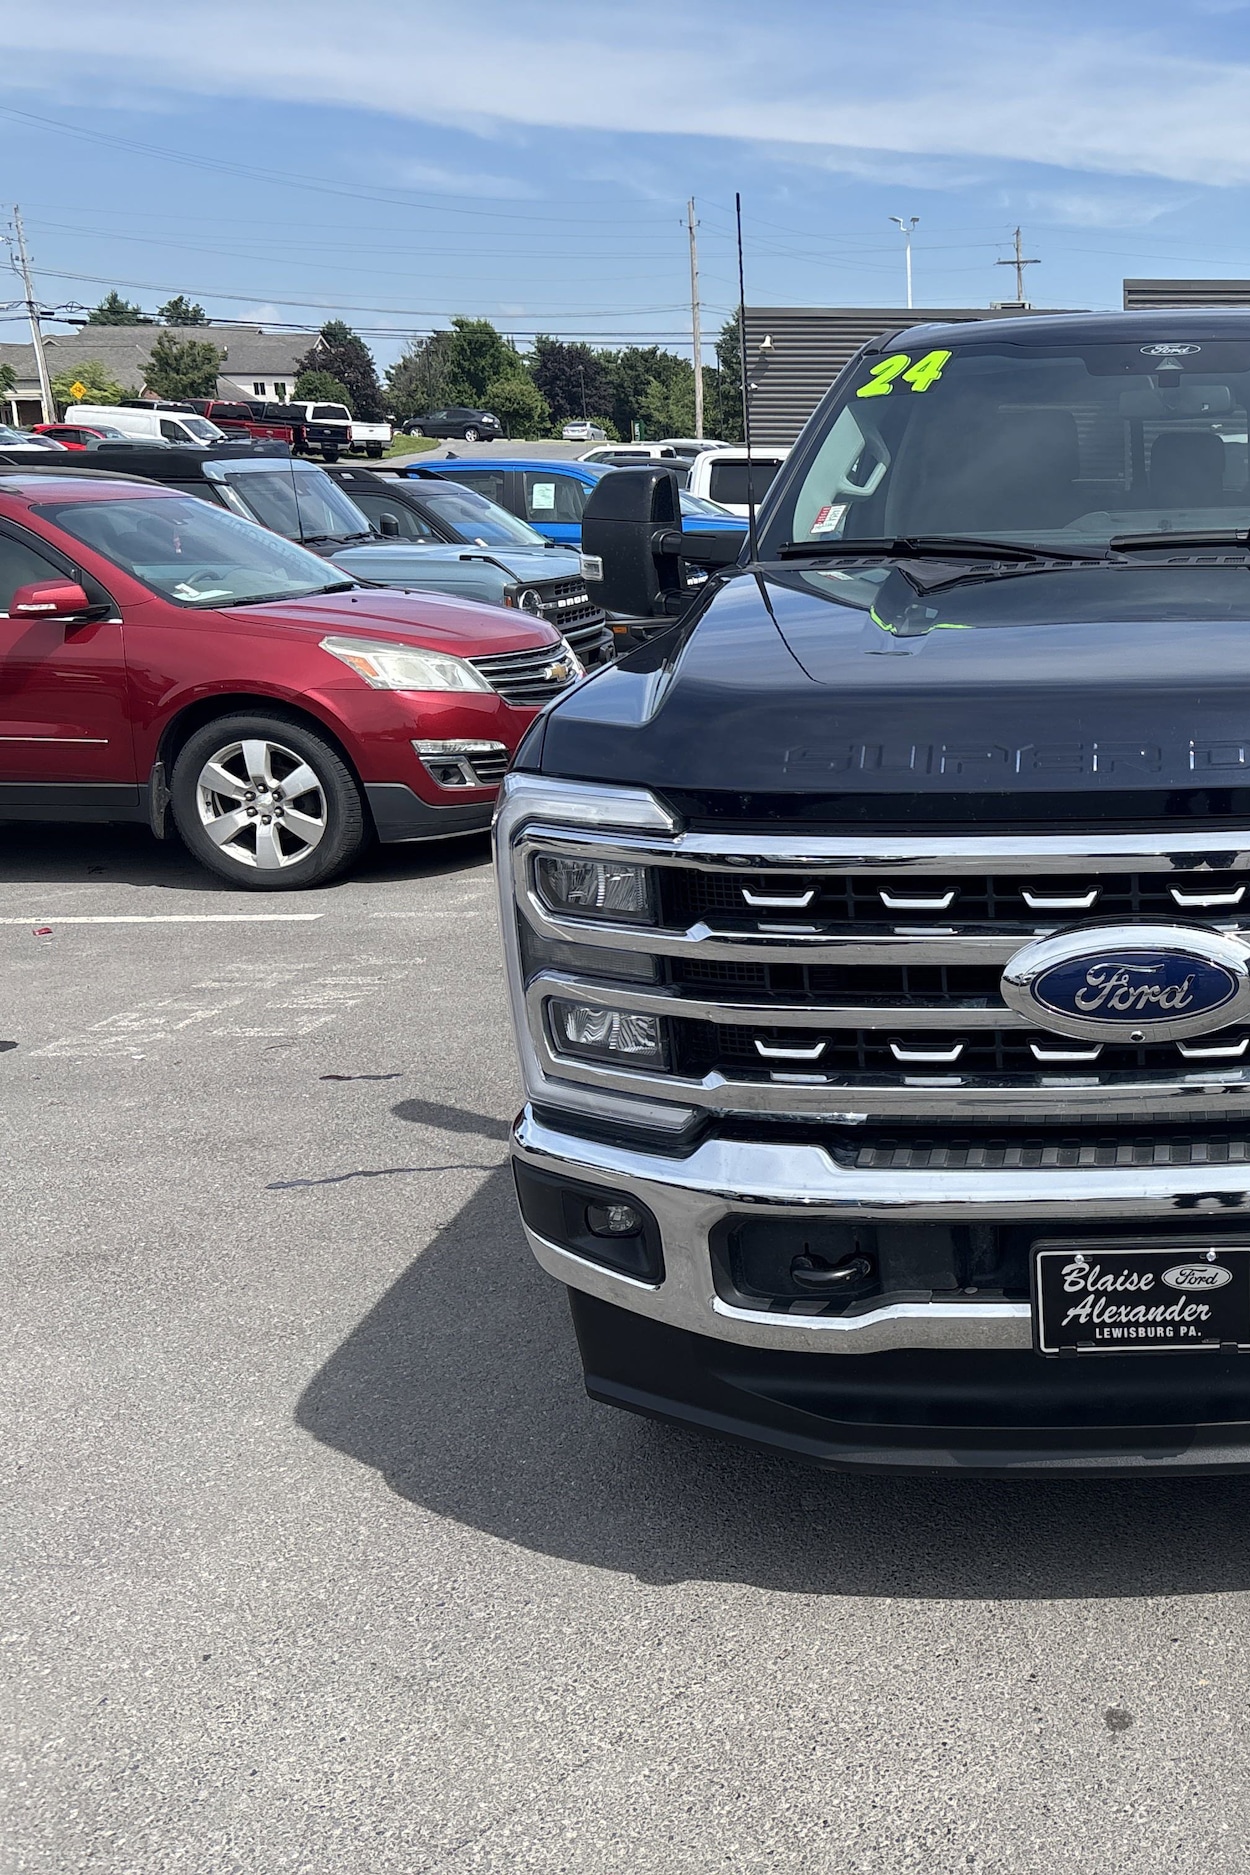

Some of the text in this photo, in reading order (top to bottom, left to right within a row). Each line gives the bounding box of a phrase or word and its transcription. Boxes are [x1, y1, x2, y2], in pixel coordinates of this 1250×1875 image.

[1151, 345, 1190, 354] Ford
[856, 350, 952, 398] 24
[783, 743, 1162, 775] SUPER
[1074, 963, 1196, 1012] Ford
[1061, 1262, 1219, 1293] Blaise Ford
[1061, 1294, 1212, 1326] Alexander
[1095, 1326, 1202, 1339] LEWISBURG PA.
